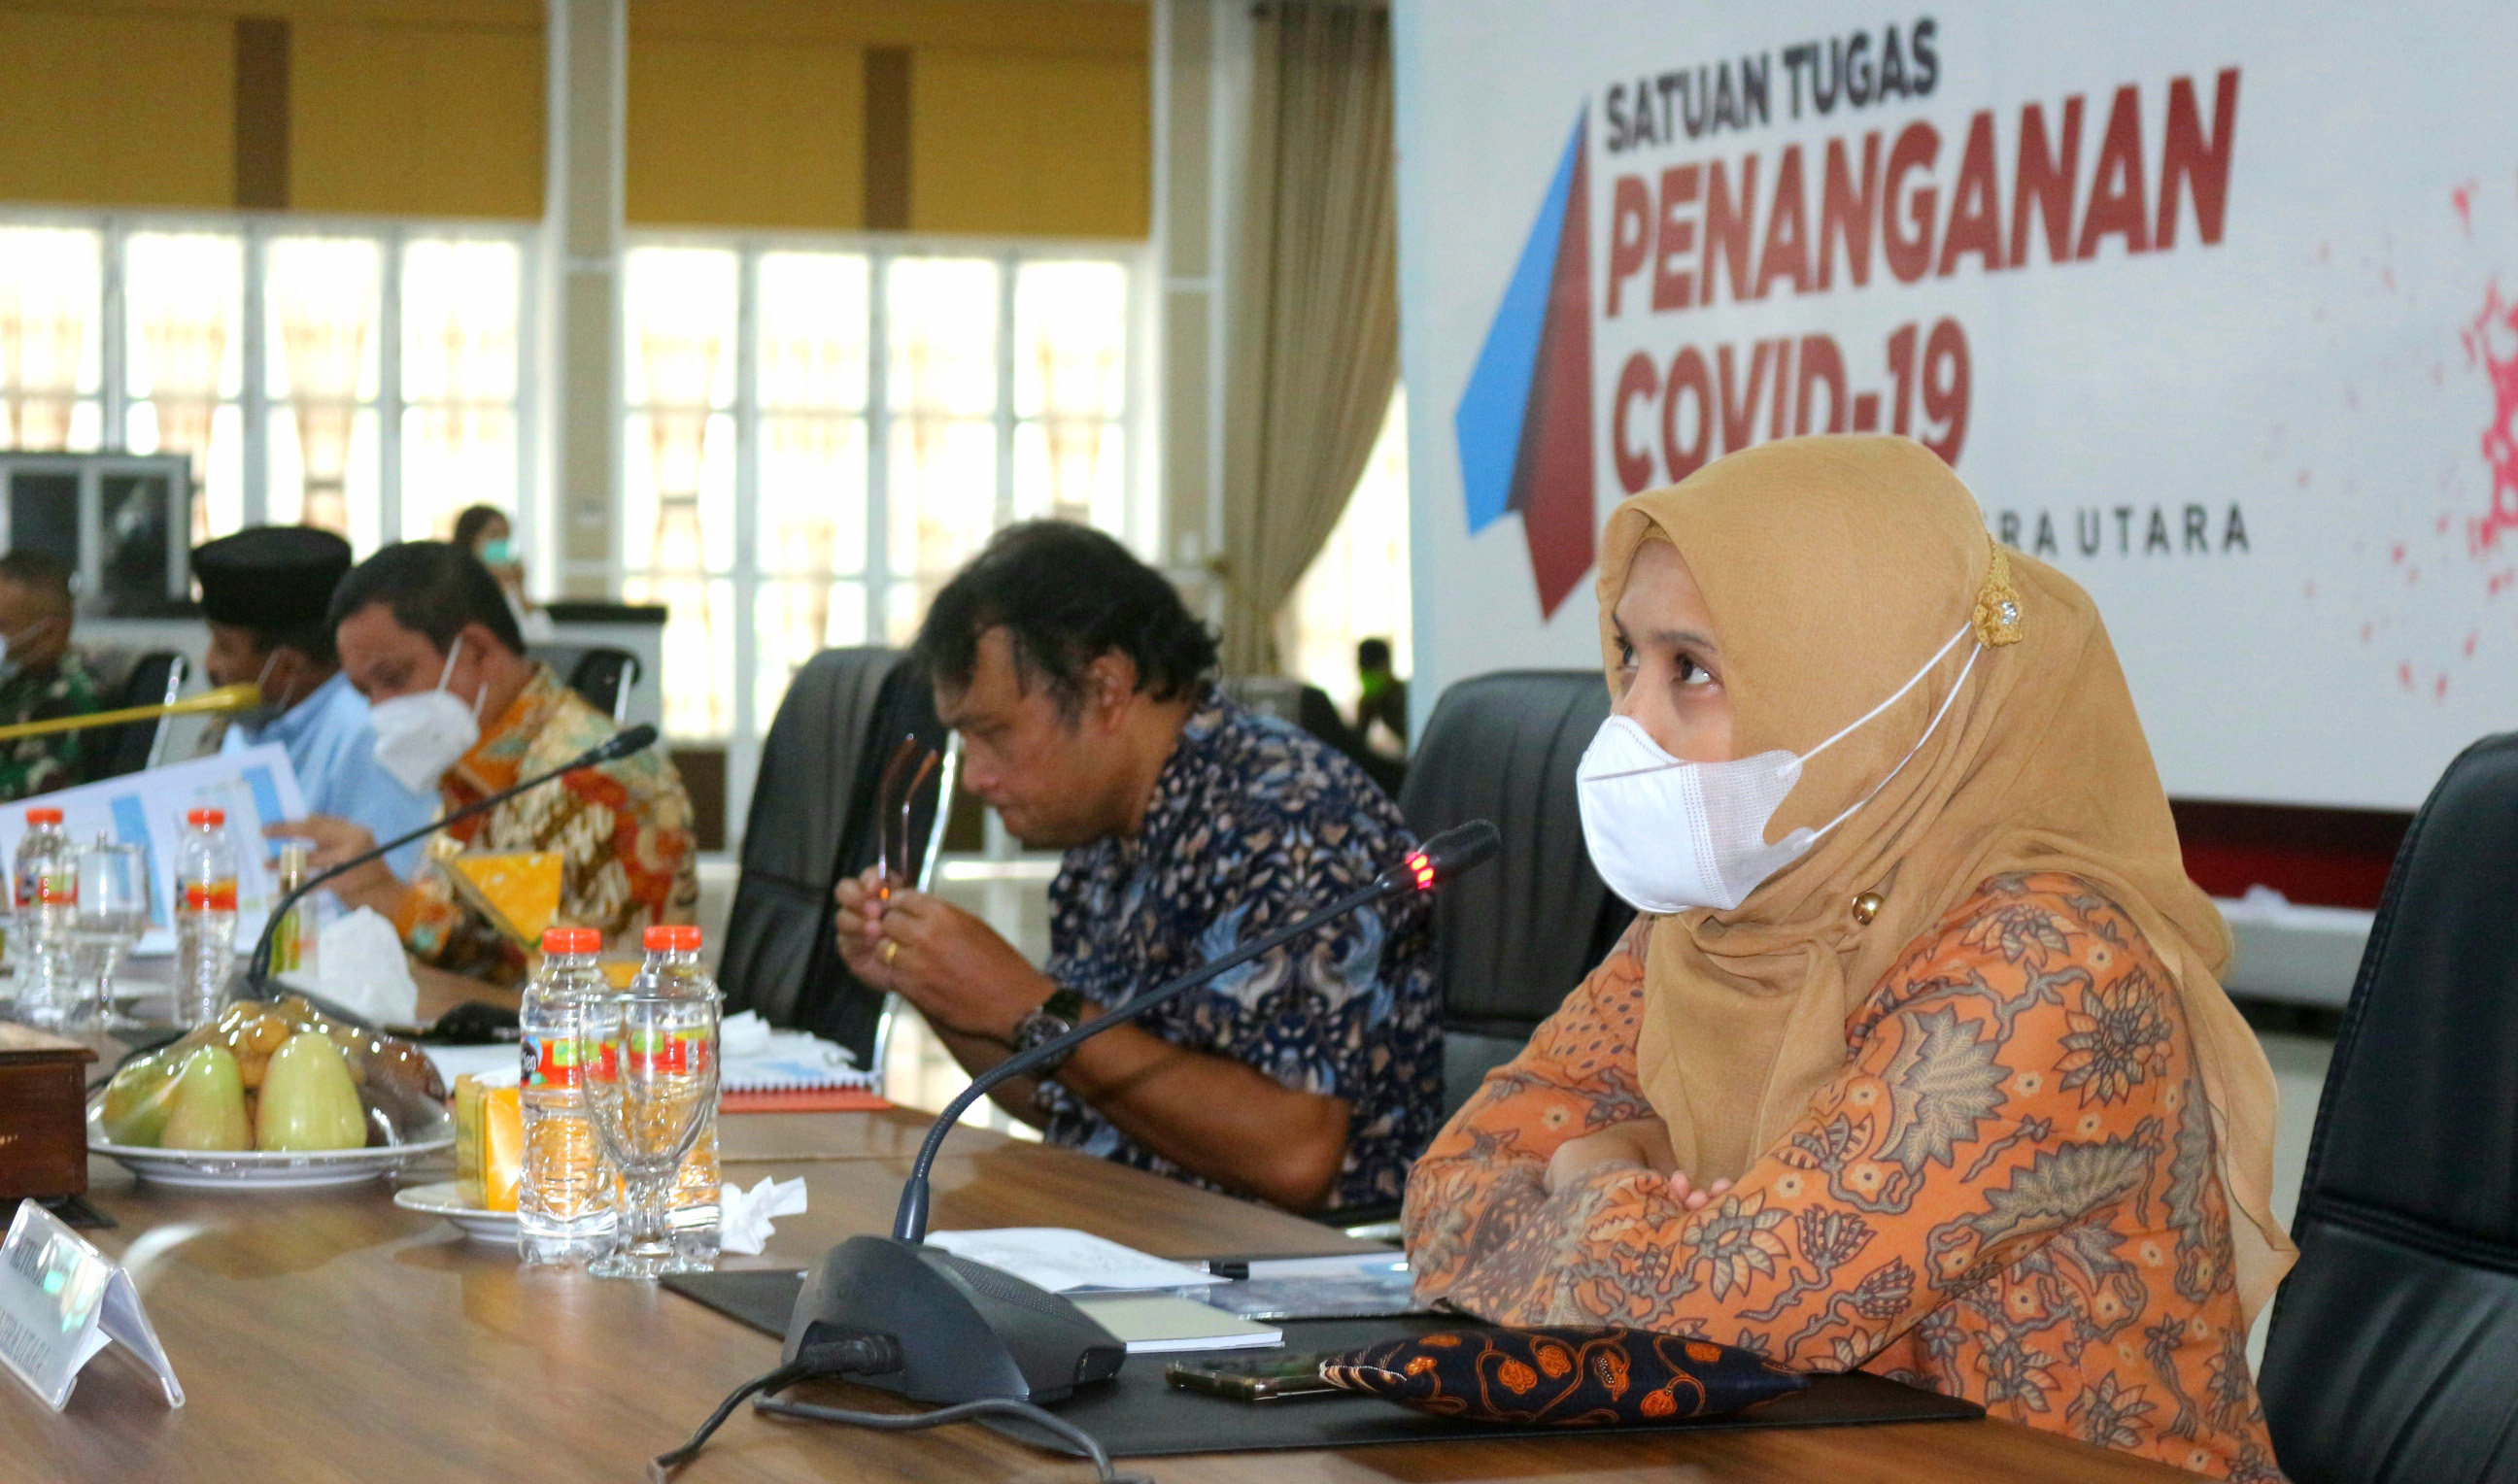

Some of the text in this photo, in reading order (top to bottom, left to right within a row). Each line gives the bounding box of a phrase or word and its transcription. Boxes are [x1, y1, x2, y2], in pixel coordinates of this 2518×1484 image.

[1606, 17, 1940, 153] SATUAN TUGAS
[1605, 66, 2242, 319] PENANGANAN
[1612, 314, 1972, 495] COVID-19
[2075, 500, 2251, 556] UTARA
